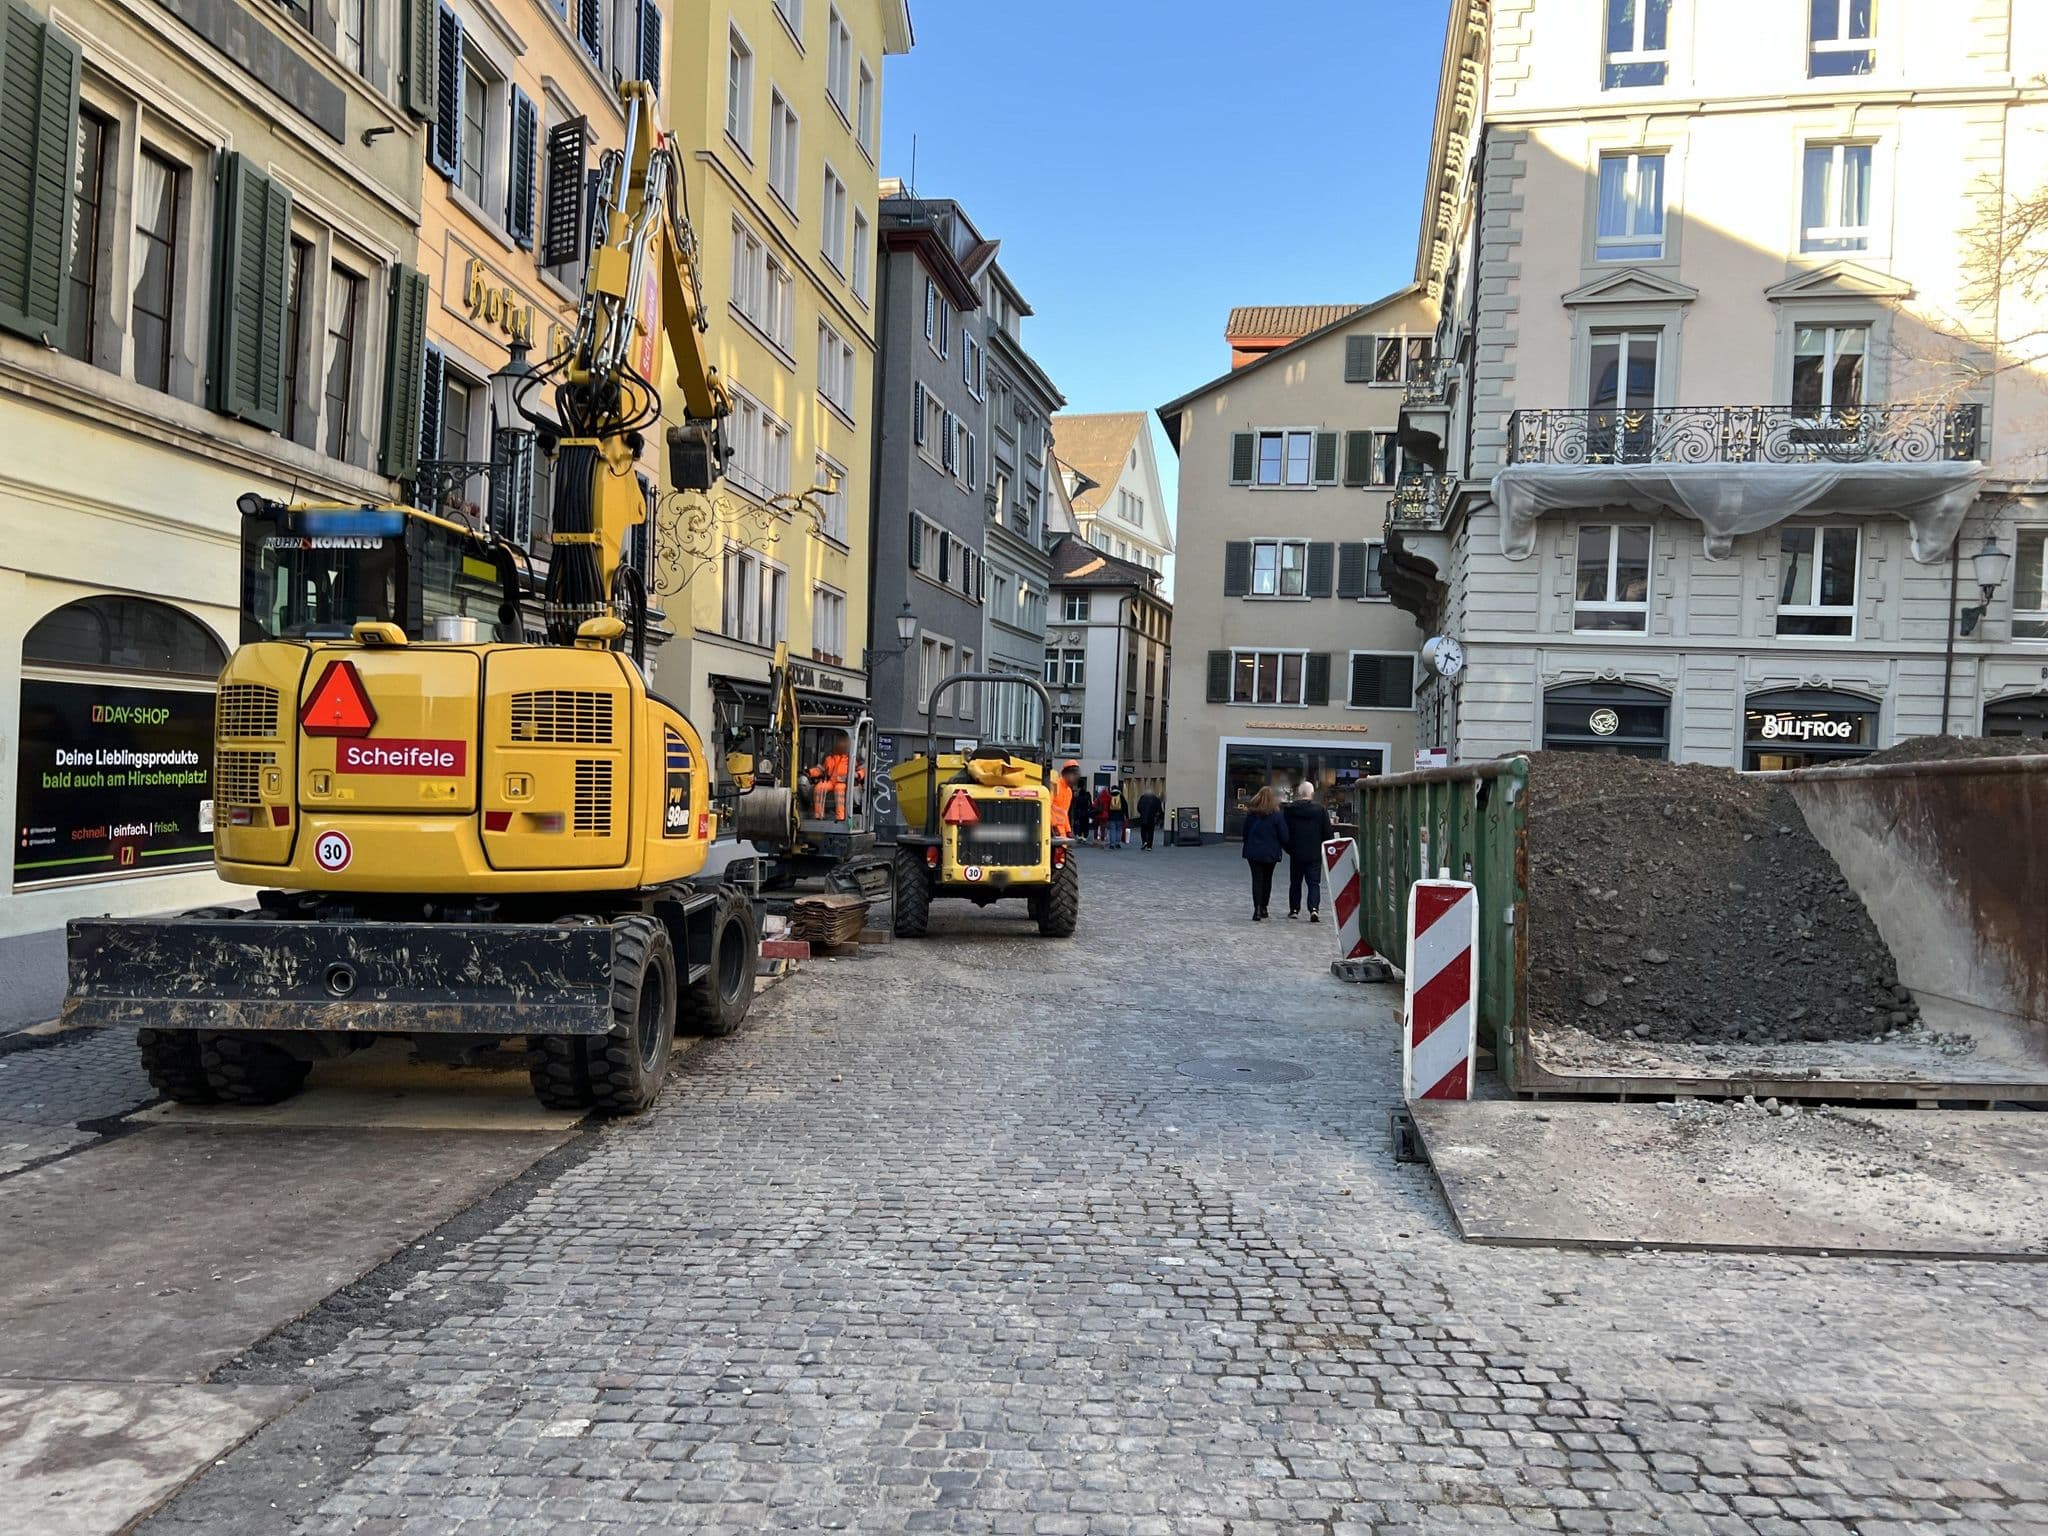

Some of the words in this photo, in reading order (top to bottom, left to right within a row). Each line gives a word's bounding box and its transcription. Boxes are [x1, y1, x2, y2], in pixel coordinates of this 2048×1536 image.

[311, 537, 384, 549] KOMATSU
[55, 749, 93, 766] Deine
[95, 749, 199, 769] Lieblingsprodukte
[347, 747, 455, 767] Scheifele
[42, 771, 71, 789] bald
[74, 771, 104, 788] auch
[107, 773, 126, 786] am
[128, 769, 208, 788] Hirschenplatz!
[71, 826, 107, 840] schnell.
[113, 823, 148, 837] einfach.
[154, 821, 180, 833] frisch.
[323, 843, 342, 860] 30
[968, 868, 979, 878] 30
